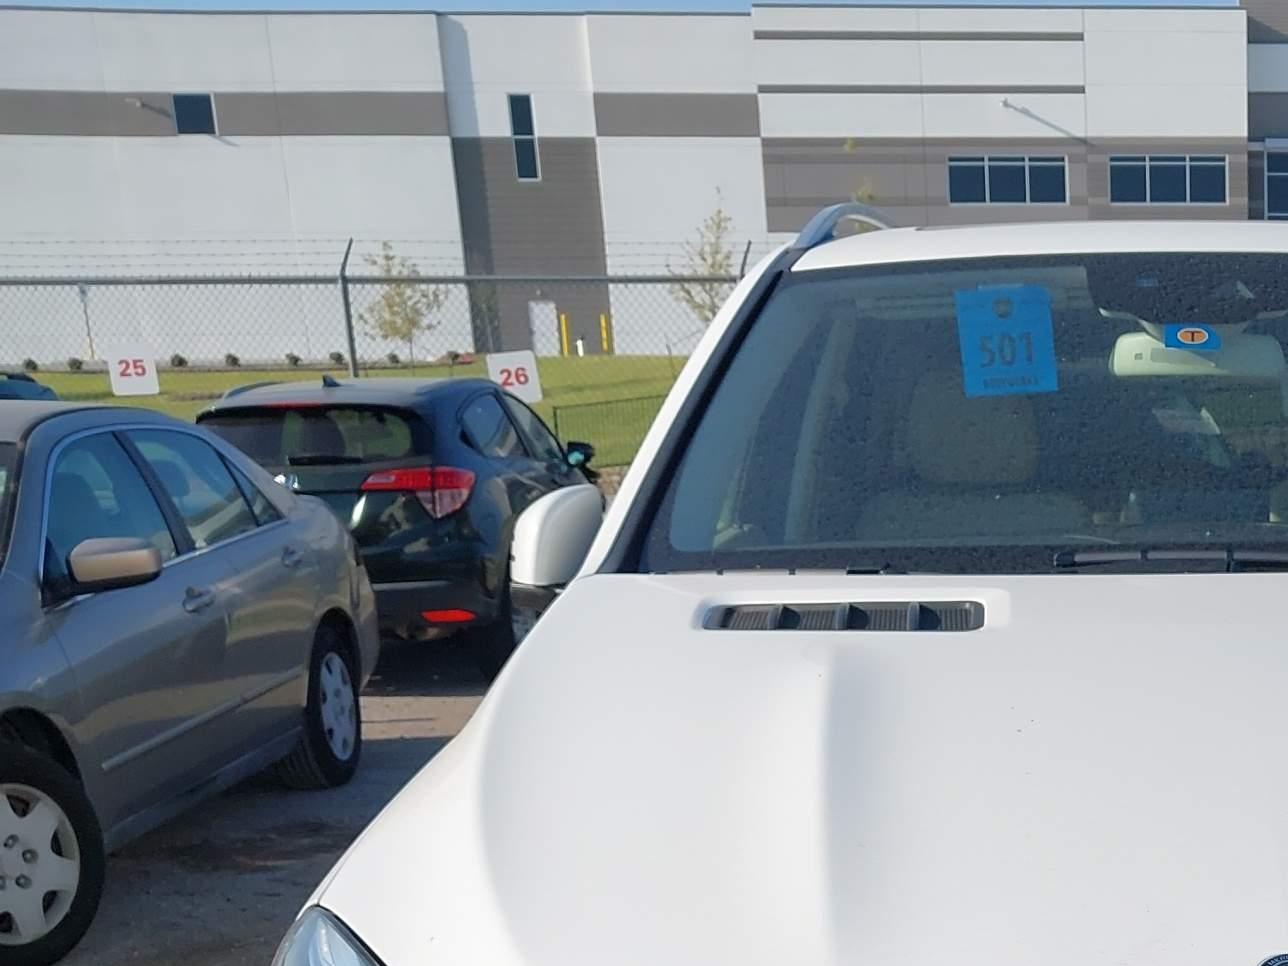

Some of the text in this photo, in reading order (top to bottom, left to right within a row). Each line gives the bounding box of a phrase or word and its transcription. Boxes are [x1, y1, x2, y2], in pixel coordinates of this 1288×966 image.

[979, 331, 1033, 368] 501
[118, 359, 146, 377] 25
[500, 367, 529, 386] 26
